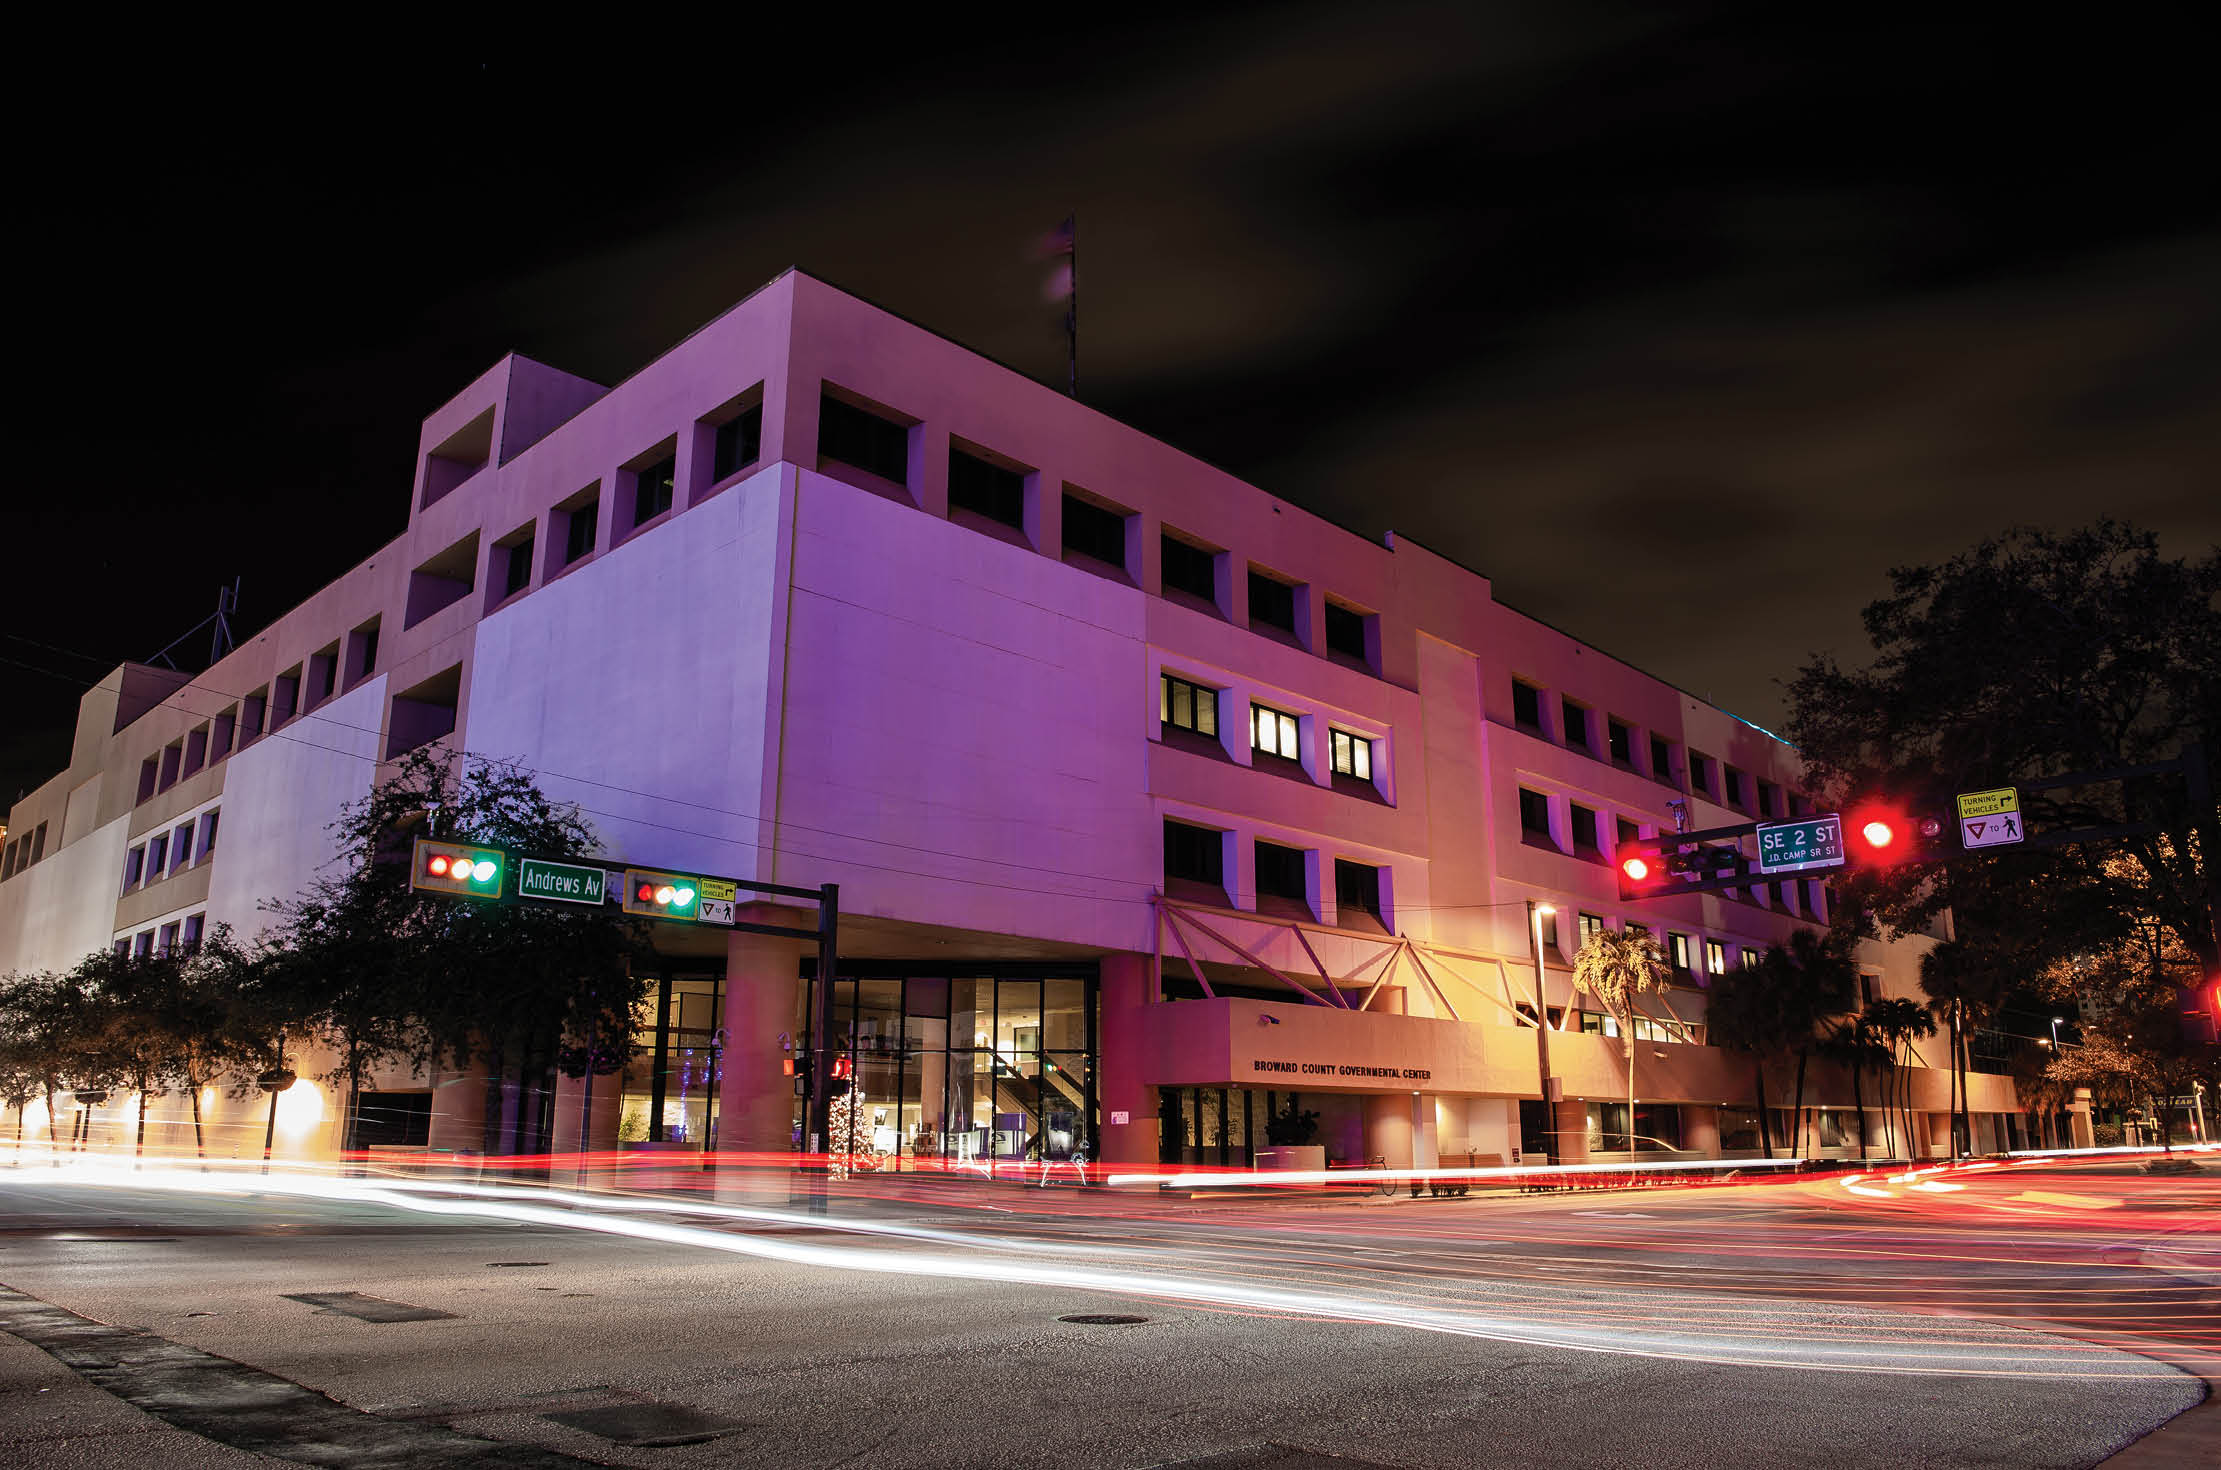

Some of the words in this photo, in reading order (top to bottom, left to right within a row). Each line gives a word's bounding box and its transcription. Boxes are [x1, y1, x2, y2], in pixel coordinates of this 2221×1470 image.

[1962, 795, 1997, 806] TURNING
[1963, 804, 1999, 816] VEHICLES
[1990, 824, 2000, 833] TO
[1763, 832, 1785, 850] SE
[1794, 829, 1806, 846] 2
[1815, 825, 1835, 843] ST
[1783, 849, 1806, 861] CAMP
[1810, 847, 1821, 857] SR
[1825, 845, 1836, 855] ST
[525, 868, 580, 894] Andrews
[584, 875, 600, 896] Av
[1254, 1060, 1298, 1073] BROWARD
[1302, 1063, 1336, 1075] COUNTY
[1339, 1066, 1401, 1078] GOVERNMENTAL
[1403, 1069, 1431, 1080] CENTER
